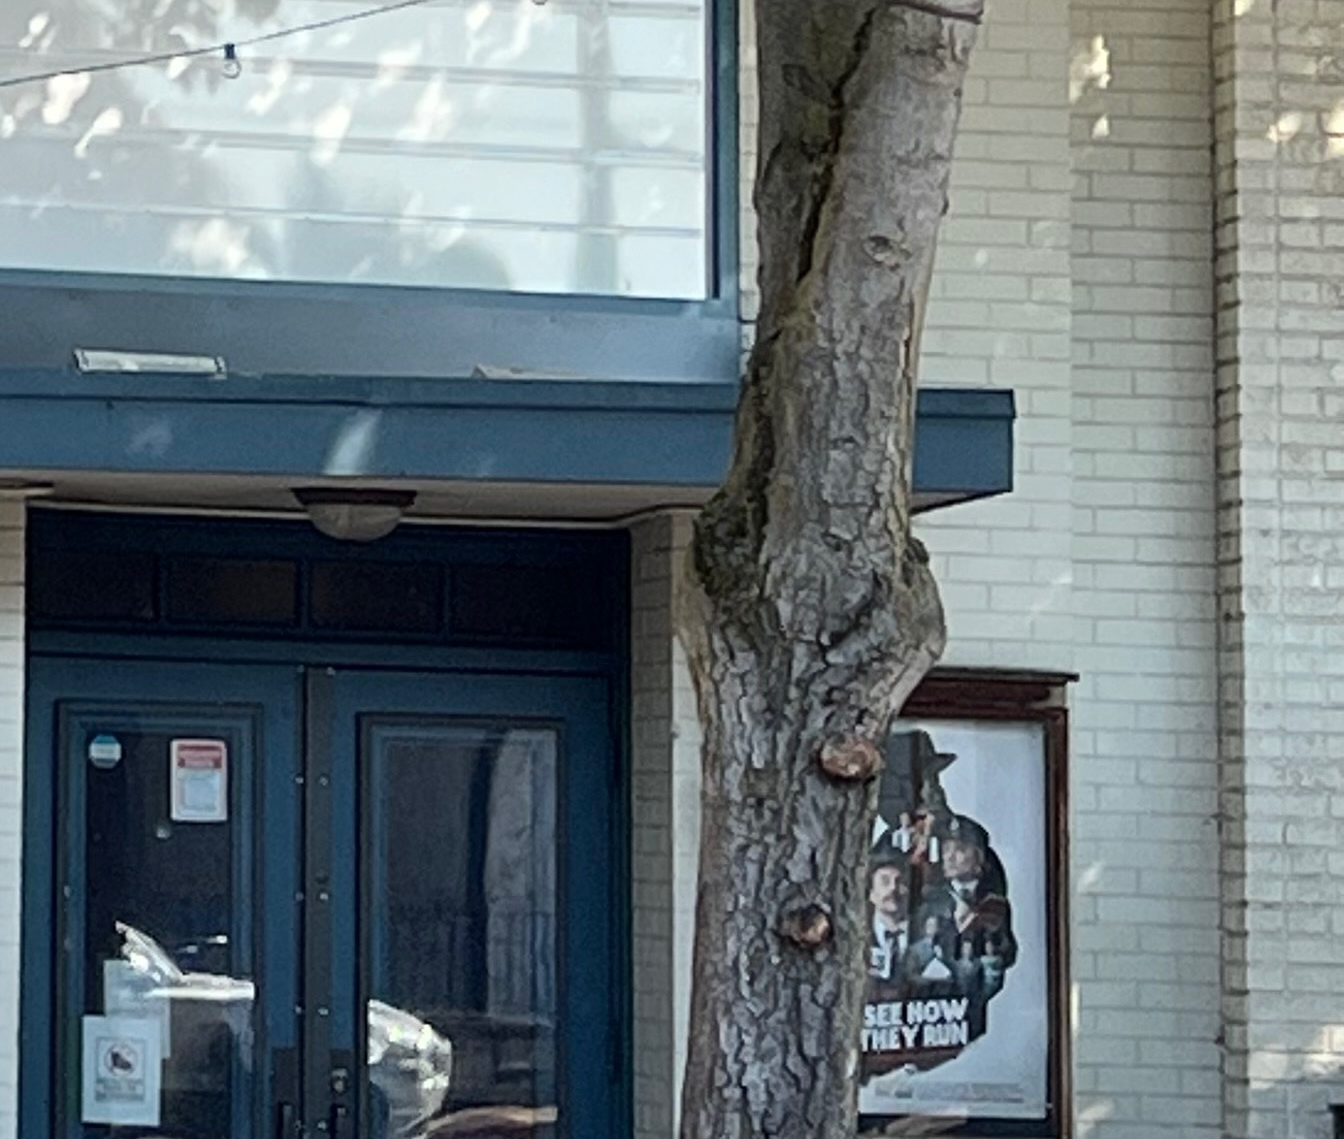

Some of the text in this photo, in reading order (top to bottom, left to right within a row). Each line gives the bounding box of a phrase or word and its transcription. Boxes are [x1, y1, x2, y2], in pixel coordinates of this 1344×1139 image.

[864, 1002, 903, 1027] SEE
[860, 1021, 968, 1052] THEY RUN
